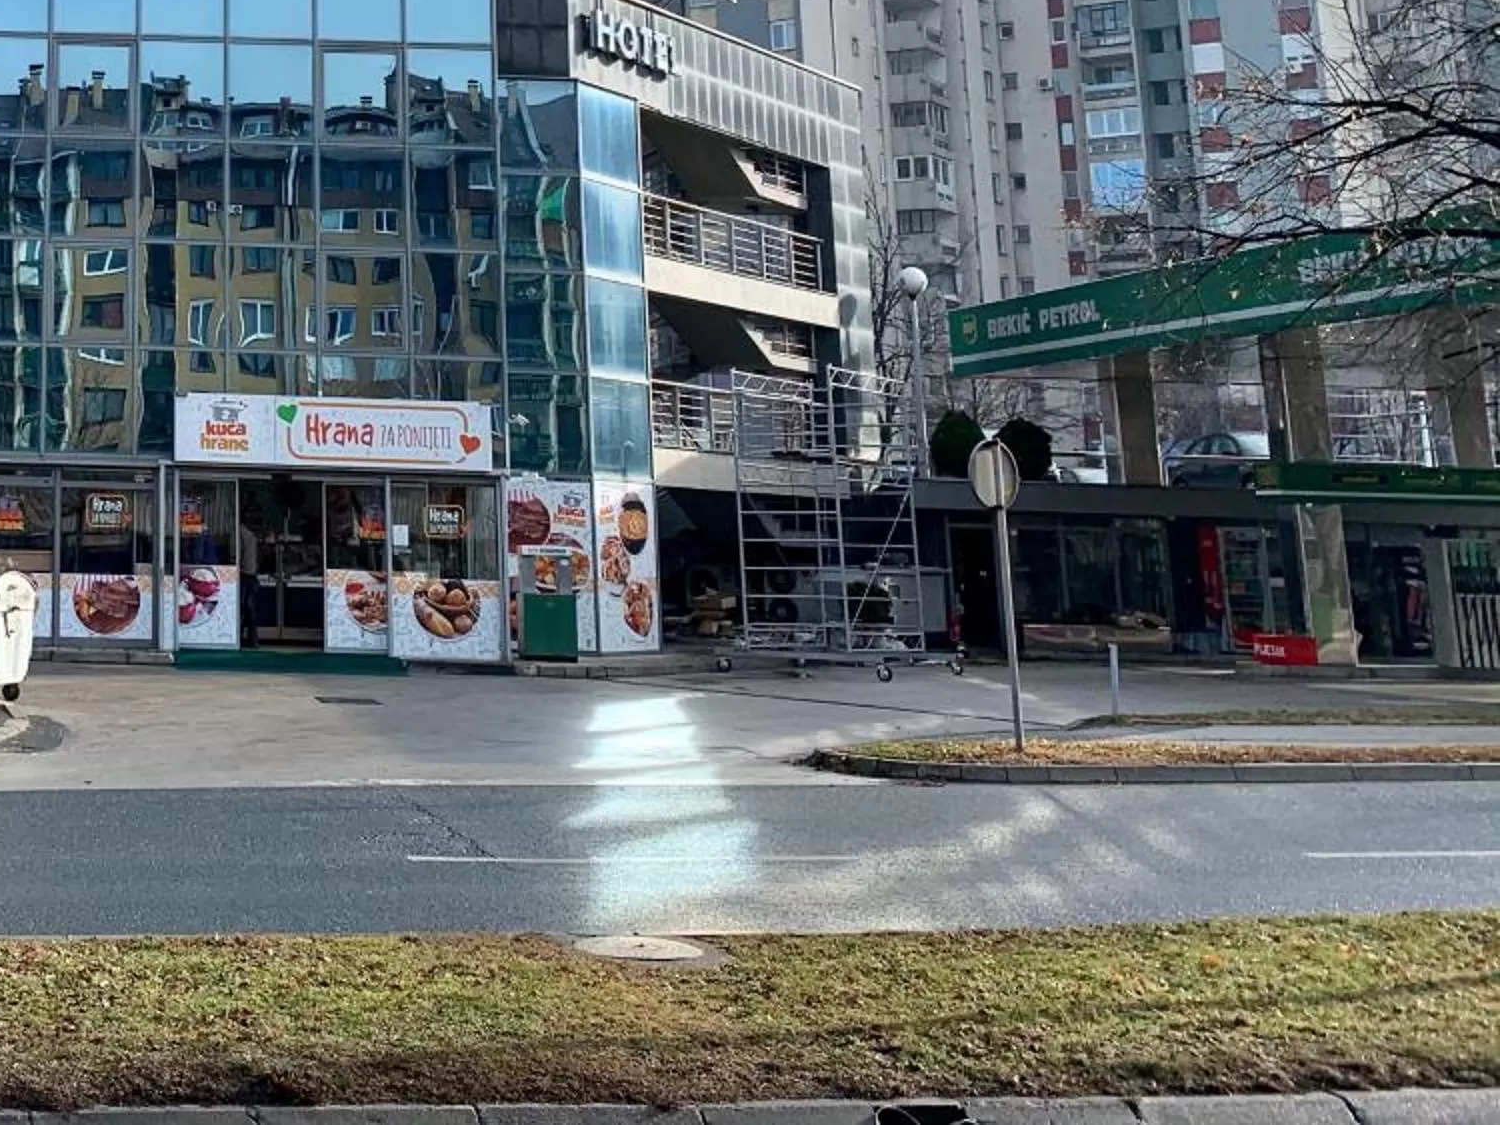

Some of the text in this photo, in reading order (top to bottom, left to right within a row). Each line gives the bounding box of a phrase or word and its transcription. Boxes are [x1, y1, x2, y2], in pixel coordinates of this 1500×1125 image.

[595, 8, 681, 76] HOTEL
[1039, 299, 1100, 331] PETROL
[305, 413, 373, 447] Hrana
